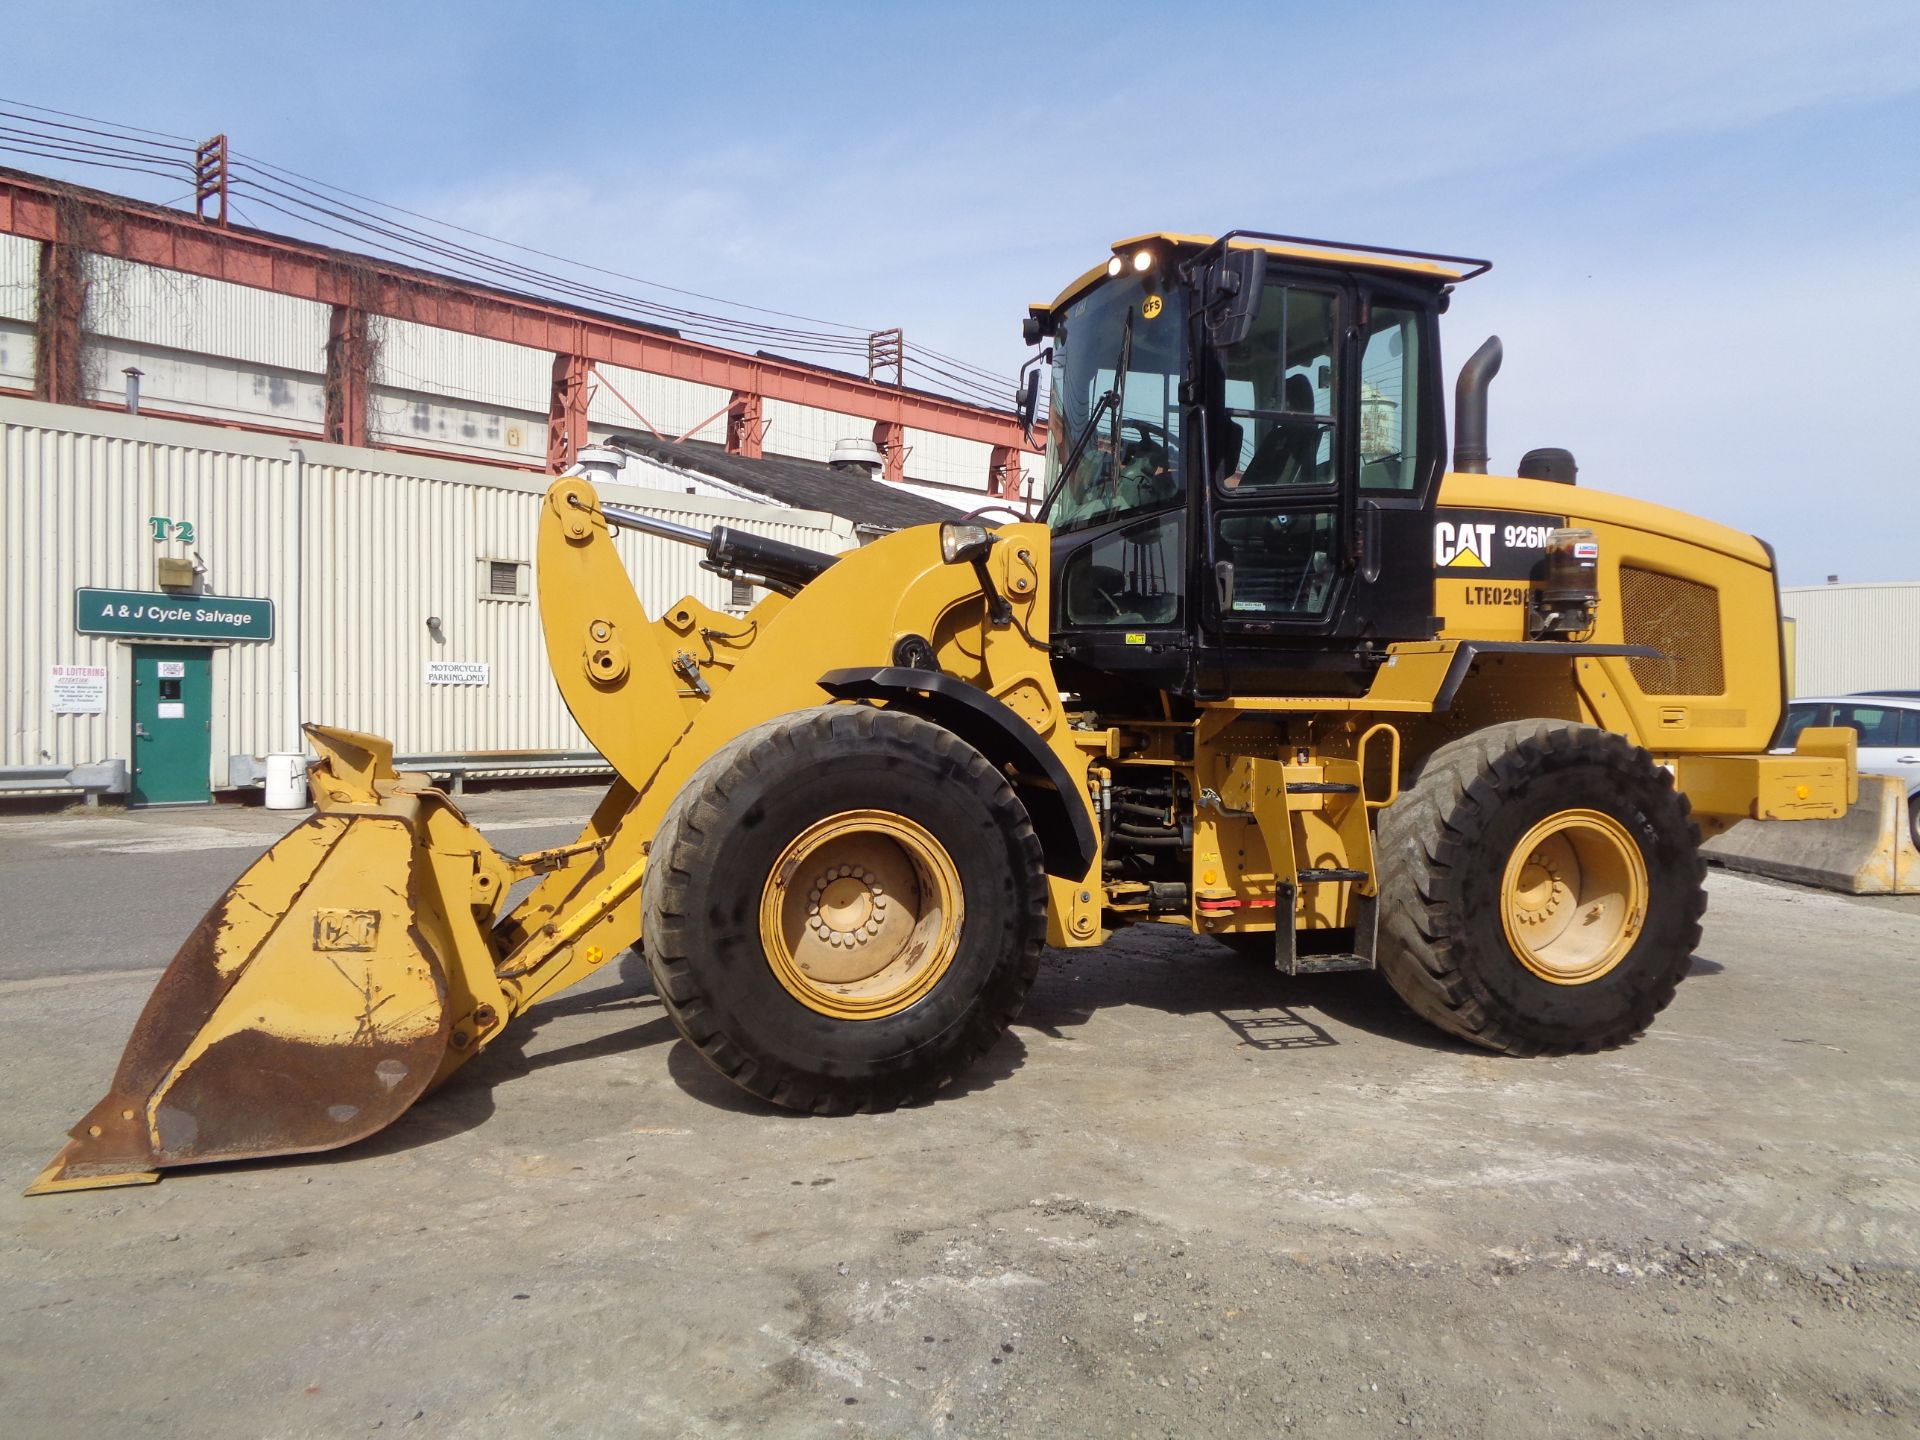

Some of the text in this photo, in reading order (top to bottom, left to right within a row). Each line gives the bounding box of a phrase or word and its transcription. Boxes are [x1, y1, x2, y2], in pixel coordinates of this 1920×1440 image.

[1143, 299, 1160, 314] CFS
[1435, 522, 1555, 568] CAT 926M
[101, 604, 252, 626] A & J Cycle Salvage
[428, 673, 486, 682] PARKING ONLY
[431, 664, 483, 673] MOTORCYCLE
[319, 914, 375, 948] CAT
